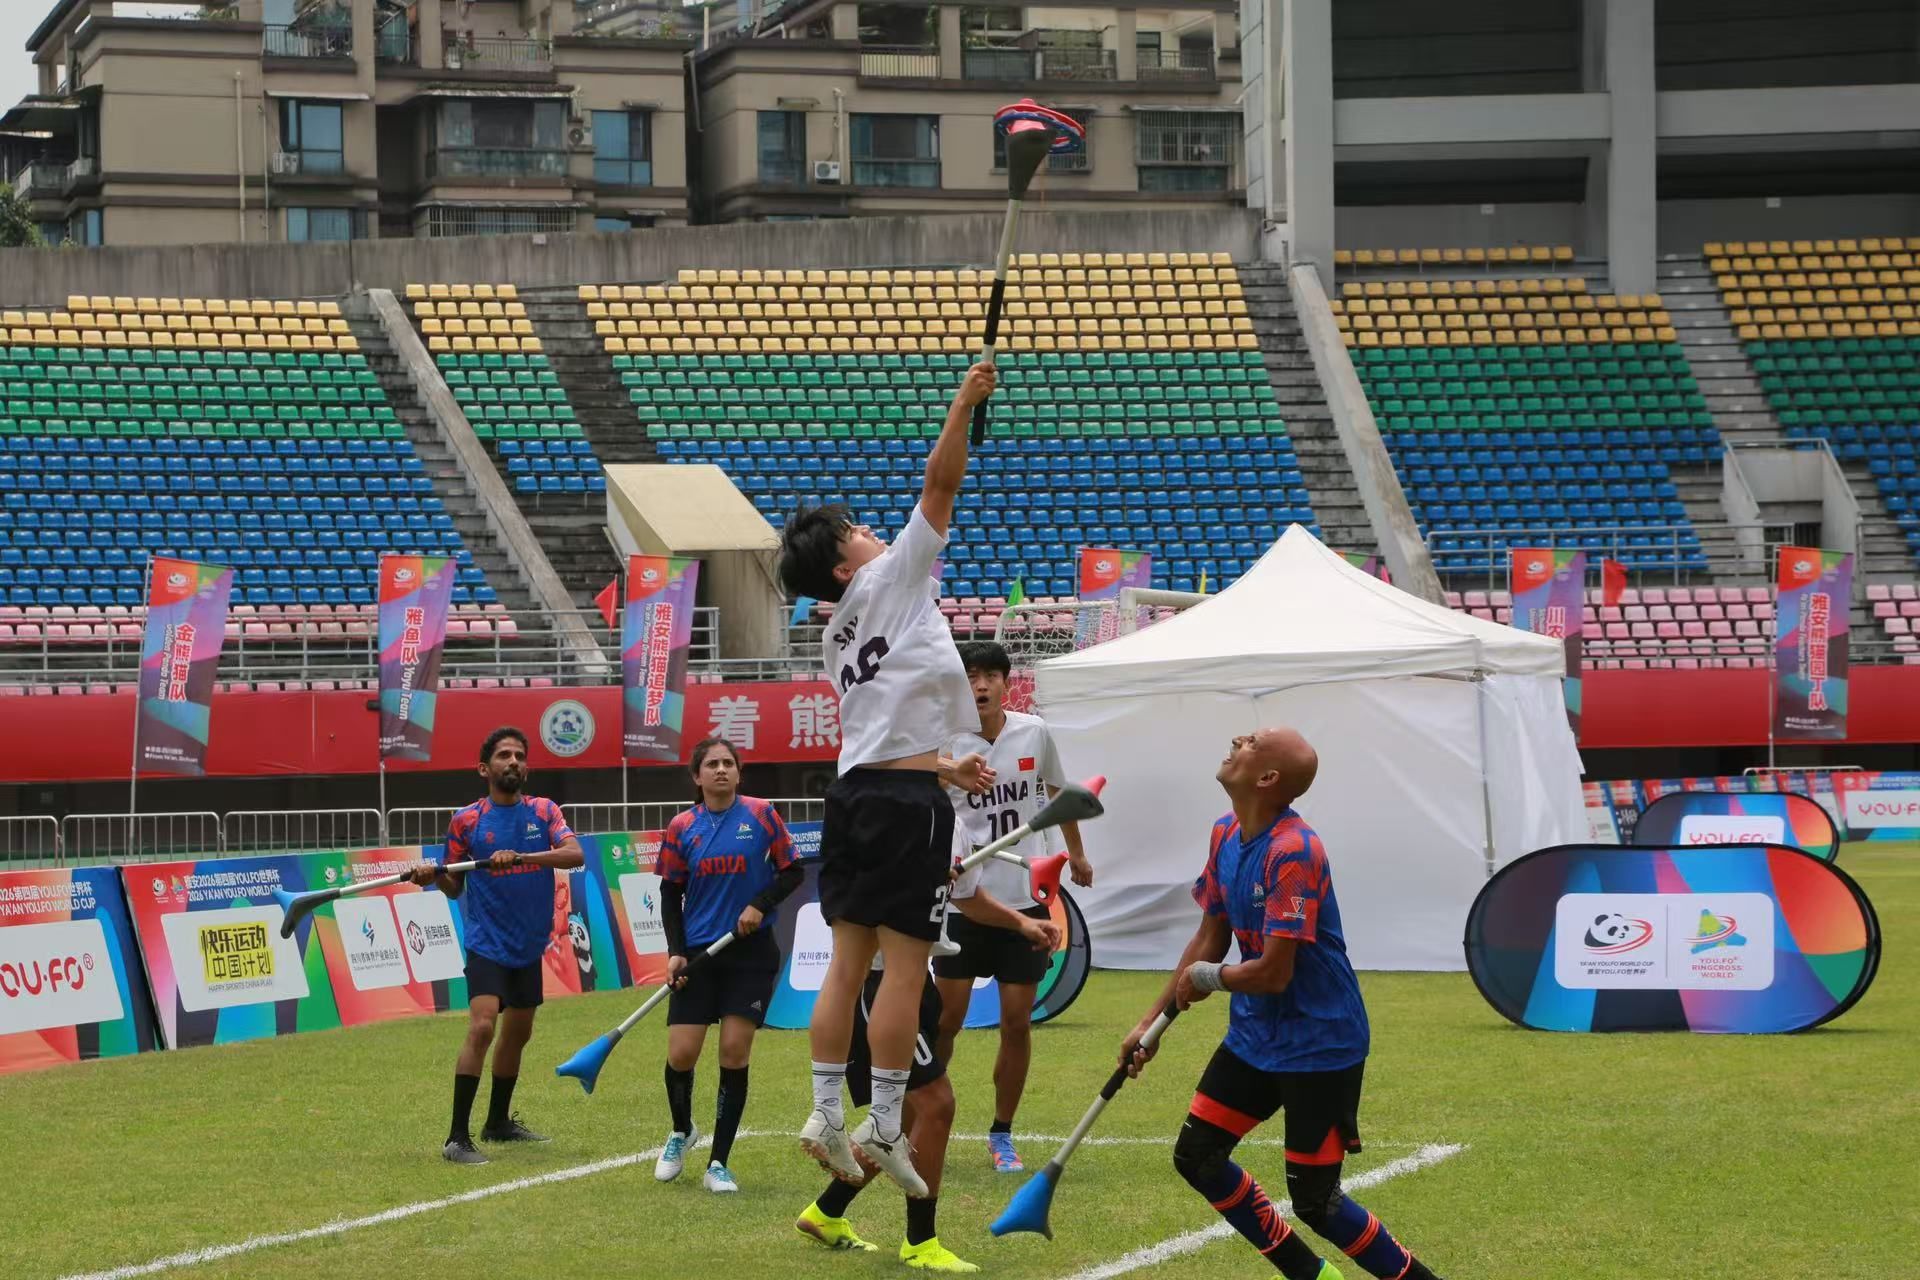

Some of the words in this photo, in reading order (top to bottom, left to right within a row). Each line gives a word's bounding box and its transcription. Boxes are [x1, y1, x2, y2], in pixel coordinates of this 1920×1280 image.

[400, 607, 424, 666] 雅鱼队
[160, 652, 171, 677] Panda
[168, 623, 196, 703] 金熊猫队
[645, 602, 673, 726] 雅安熊猫追梦队
[398, 691, 412, 720] Team
[967, 780, 1029, 810] CHINA
[987, 809, 1021, 846] 10
[51, 898, 80, 912] WORLD
[80, 897, 97, 910] CUP
[246, 885, 270, 896] WORLD
[201, 925, 267, 956] 快乐运动
[212, 951, 271, 978] 中国计划
